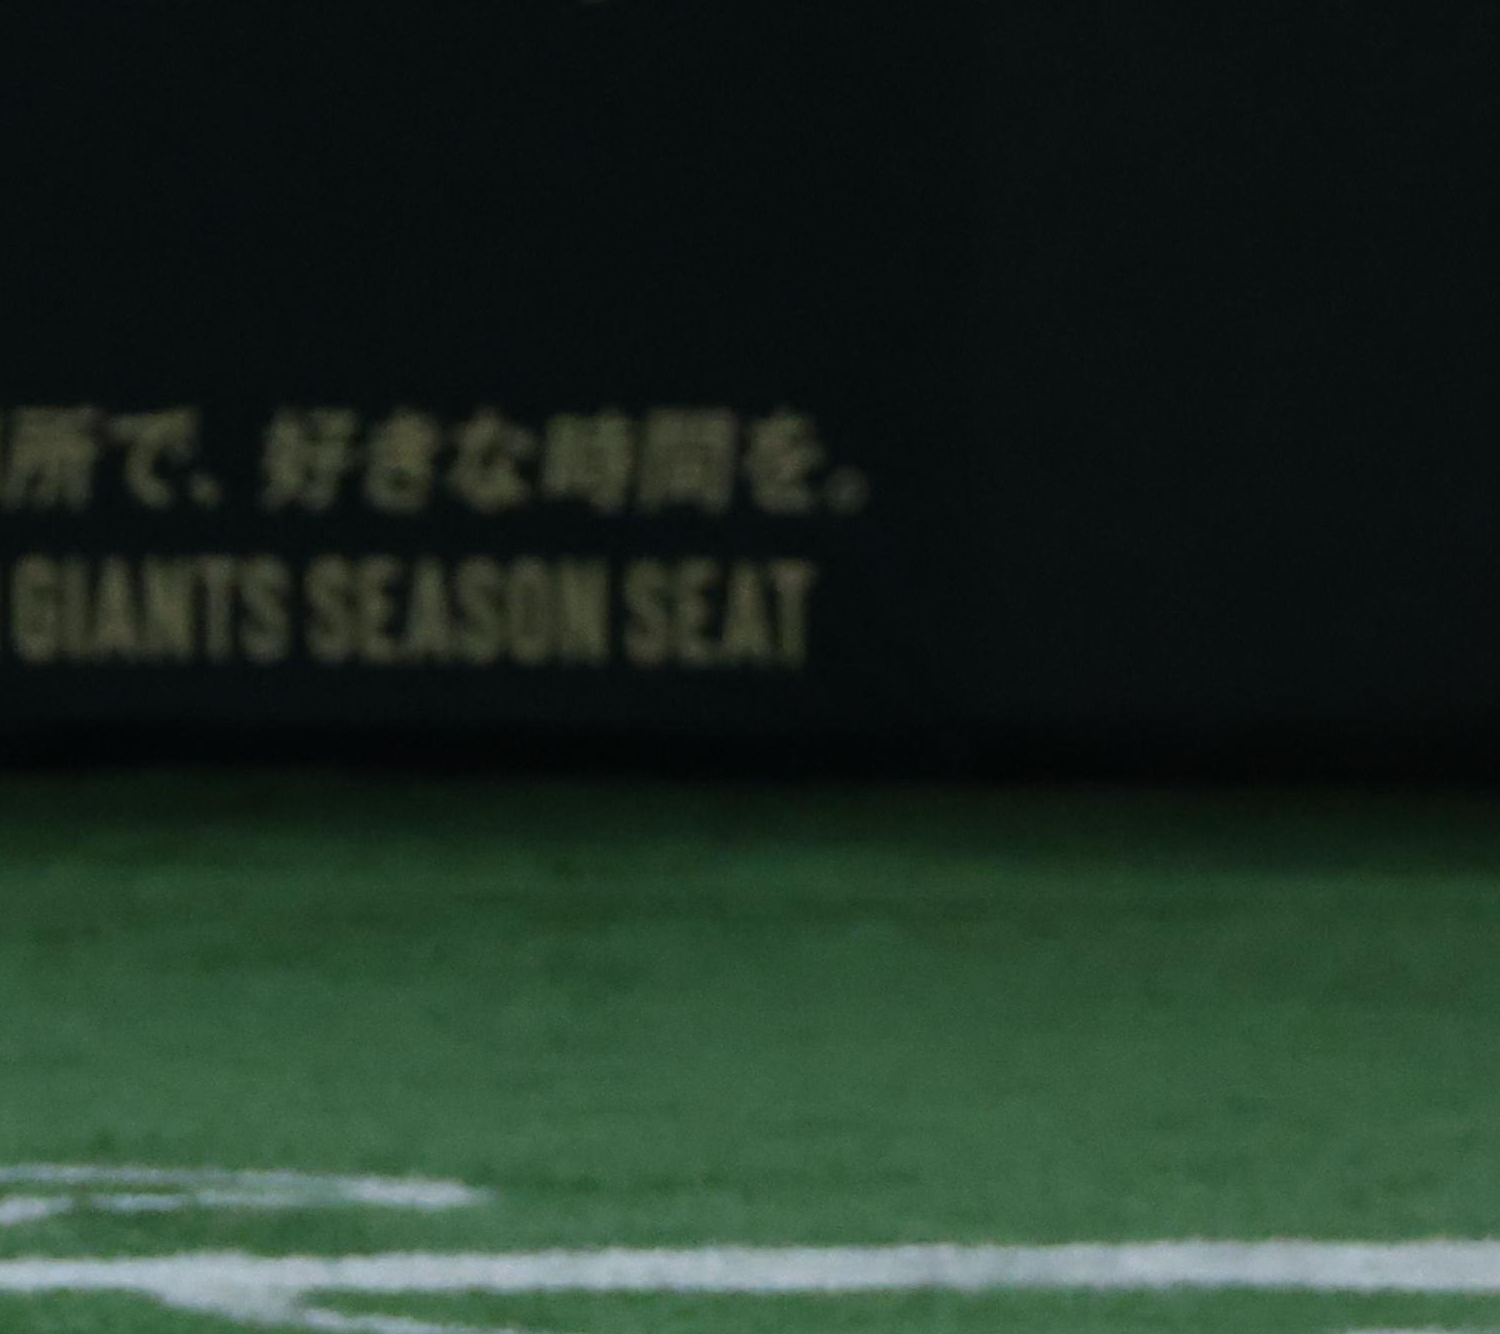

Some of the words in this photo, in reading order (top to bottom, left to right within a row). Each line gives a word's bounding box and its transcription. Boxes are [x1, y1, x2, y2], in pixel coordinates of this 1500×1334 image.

[7, 553, 295, 666] GIANTS
[301, 553, 614, 667] SEASON
[620, 555, 820, 667] SEAT
